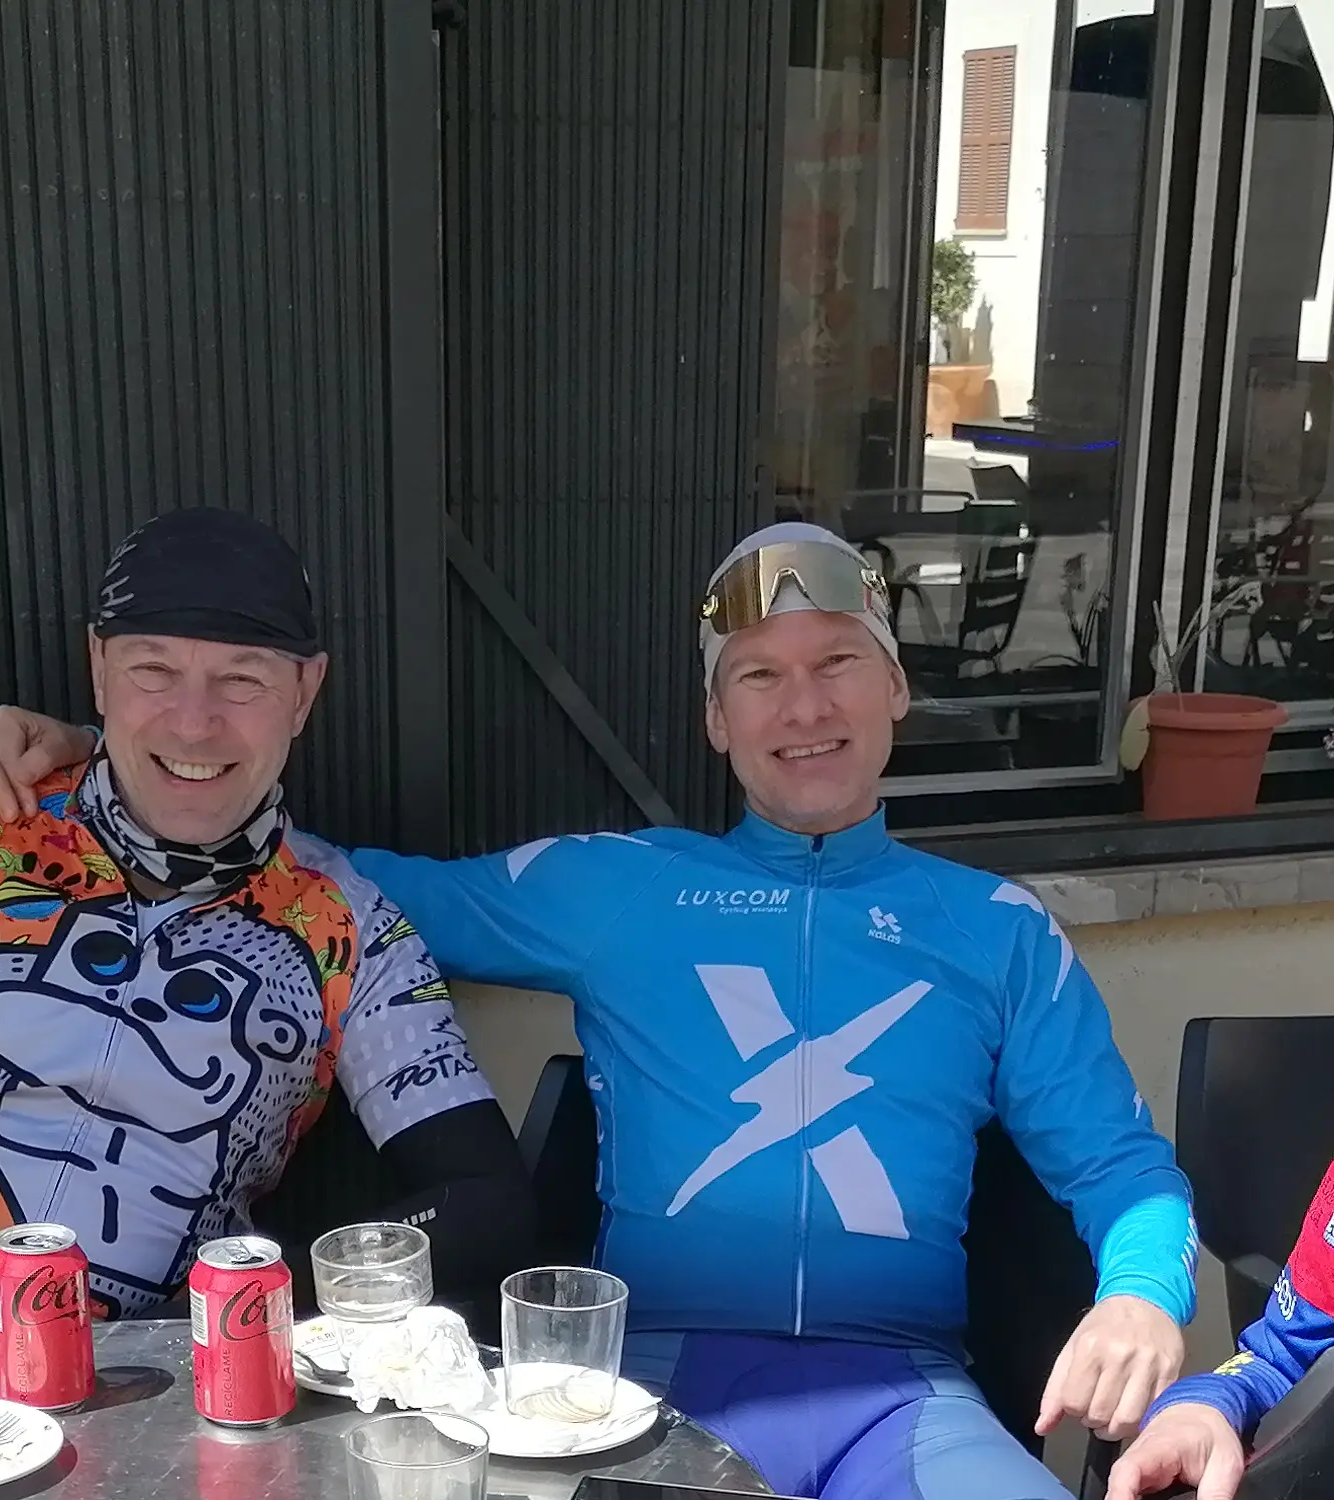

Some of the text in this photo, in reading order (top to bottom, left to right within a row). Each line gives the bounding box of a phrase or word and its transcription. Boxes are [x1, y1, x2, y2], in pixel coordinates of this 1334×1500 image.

[675, 888, 791, 906] LUXCOM
[15, 1332, 29, 1402] RECICLAME
[221, 1347, 233, 1418] RECICLAME
